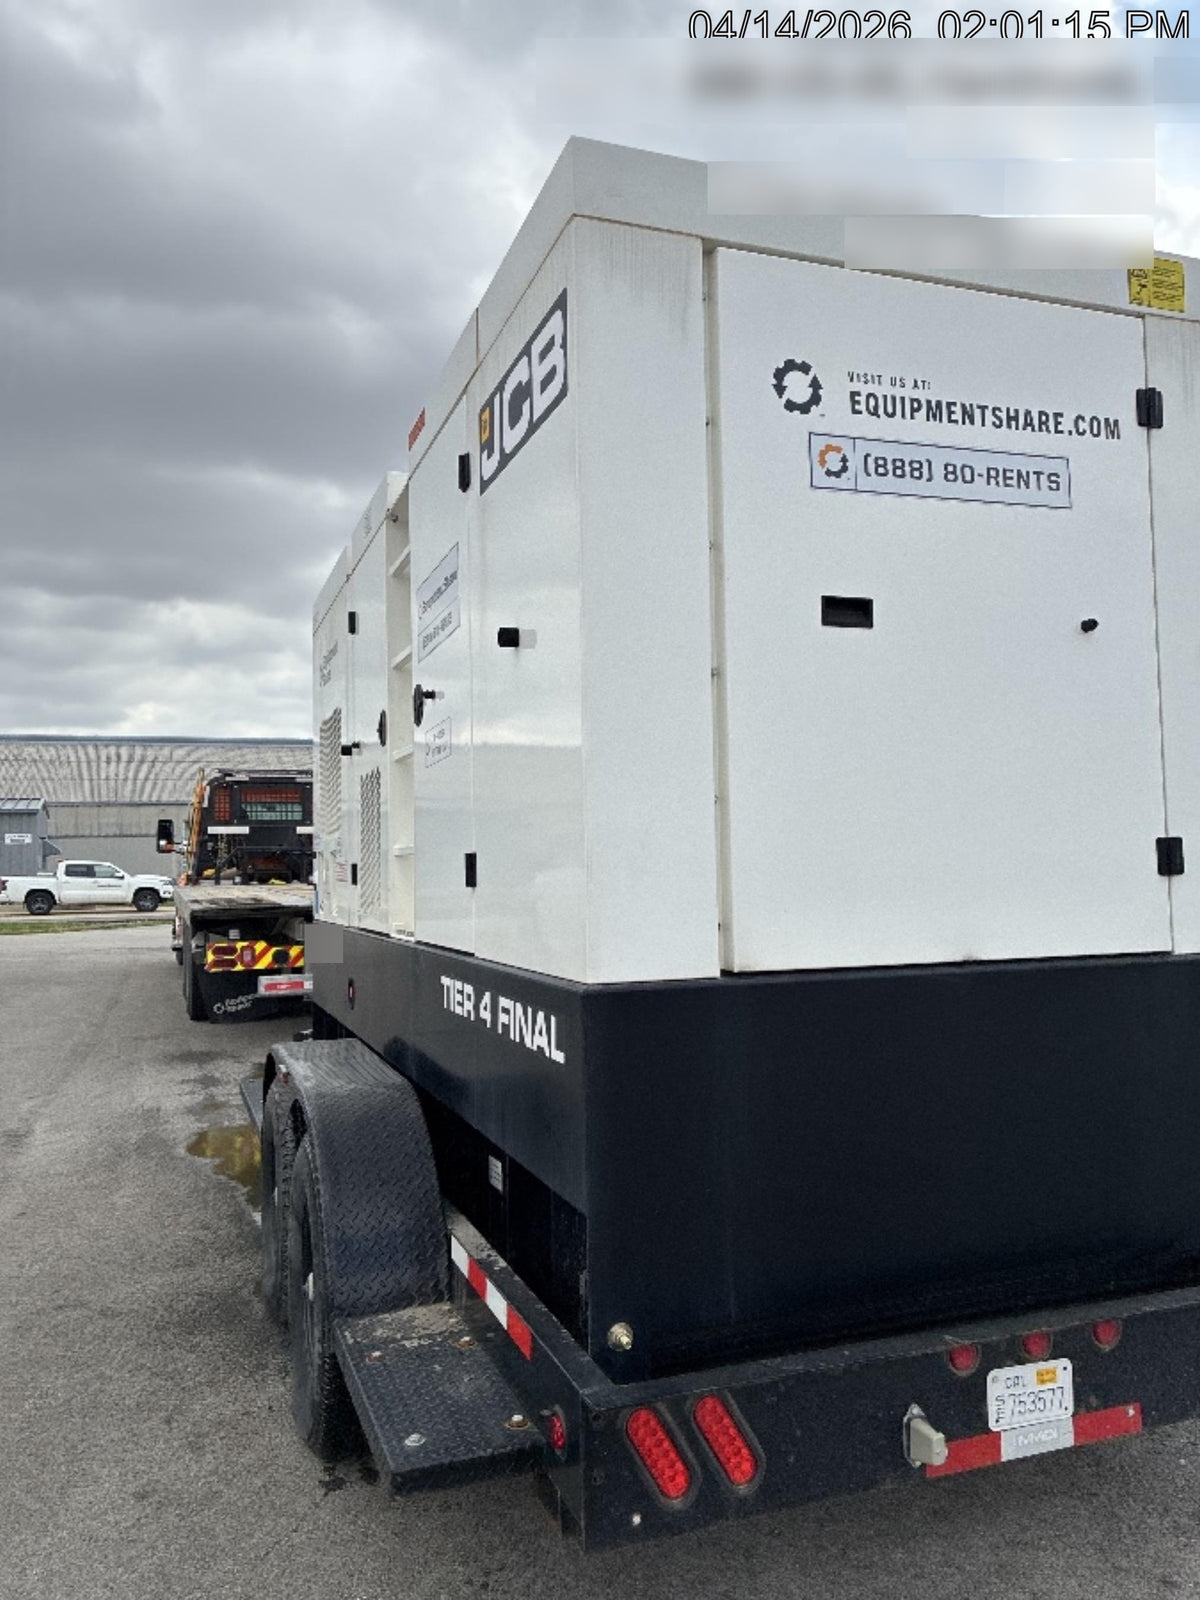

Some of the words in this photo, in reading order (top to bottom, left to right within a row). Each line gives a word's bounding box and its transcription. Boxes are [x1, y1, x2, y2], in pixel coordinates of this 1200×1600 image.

[481, 309, 565, 481] JCB
[848, 371, 883, 386] VISIT
[890, 376, 906, 389] US
[912, 379, 931, 391] AT:
[849, 390, 1121, 440] EQUIPMENTSHARE.COM
[863, 453, 934, 482] (888)
[944, 463, 1061, 492] 80-RENTS
[440, 975, 475, 1021] TIER
[479, 991, 491, 1028] 4
[497, 996, 566, 1064] FINAL
